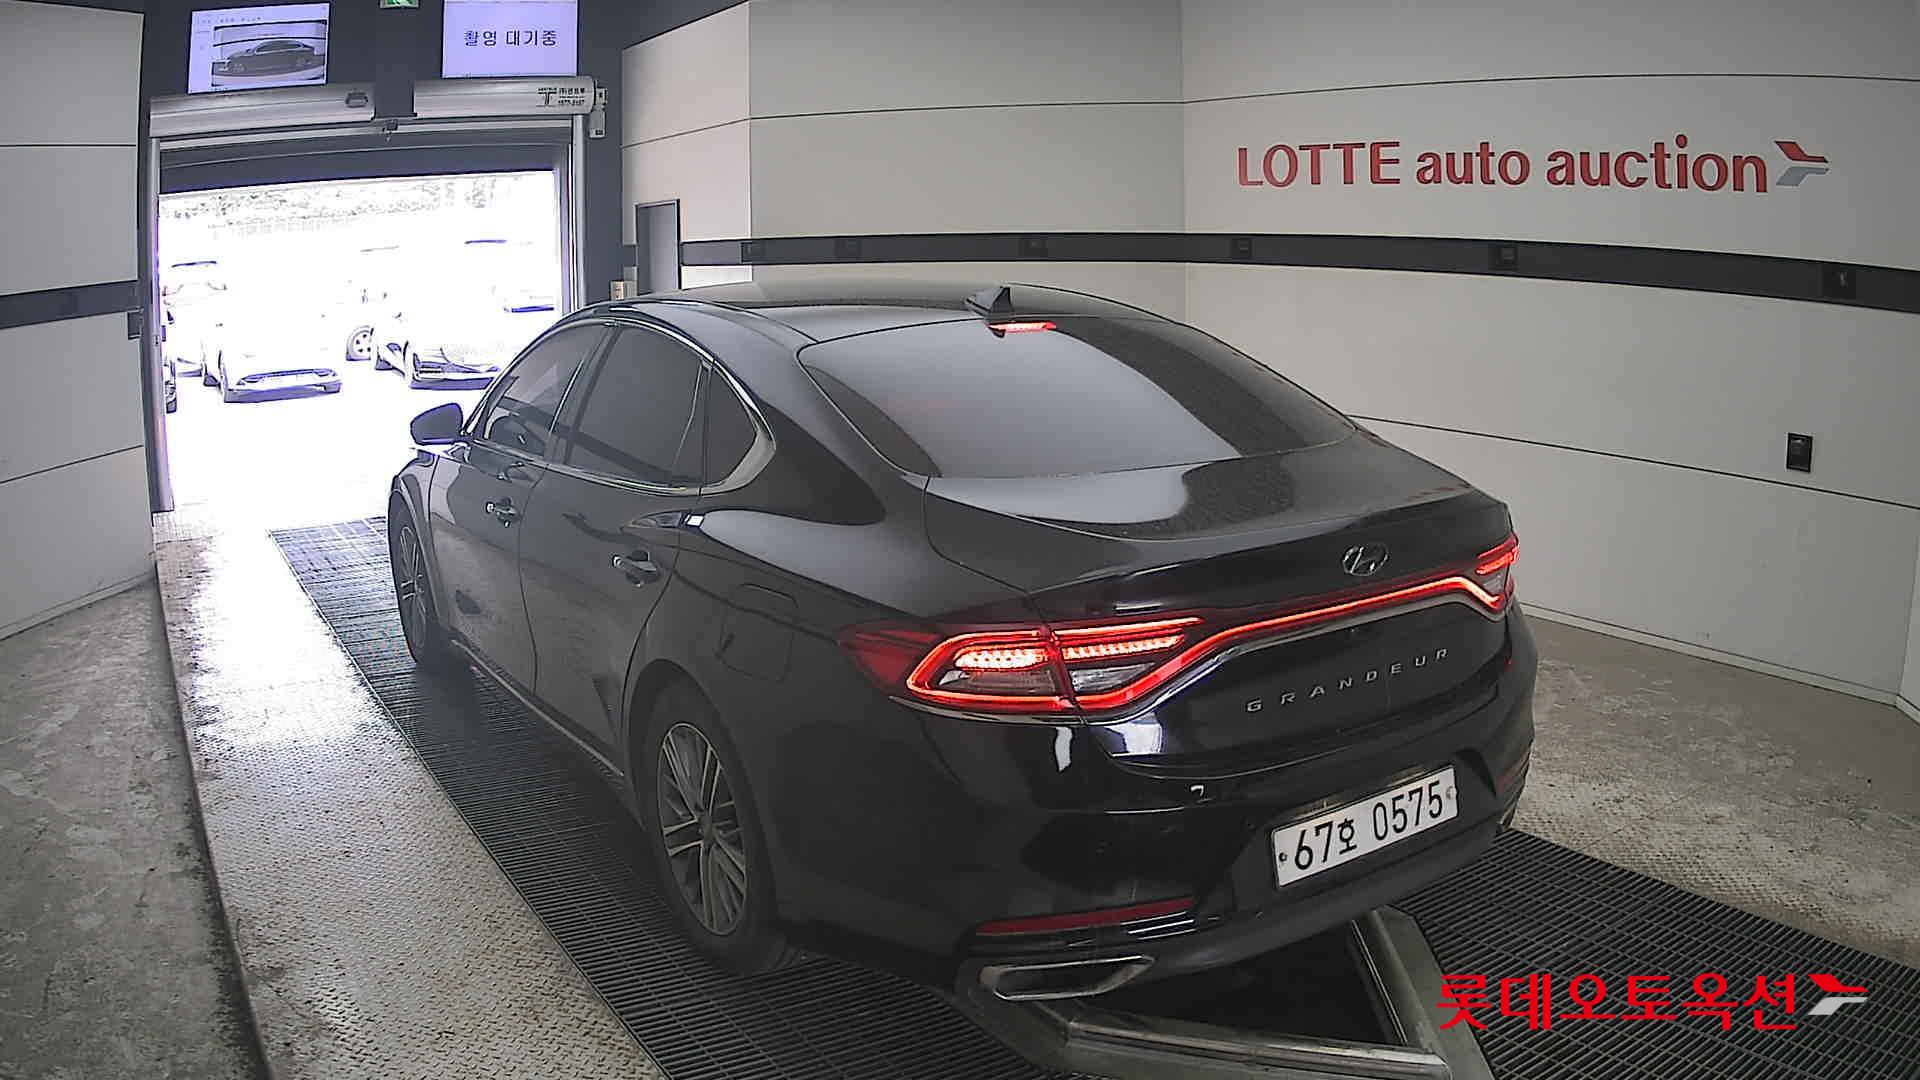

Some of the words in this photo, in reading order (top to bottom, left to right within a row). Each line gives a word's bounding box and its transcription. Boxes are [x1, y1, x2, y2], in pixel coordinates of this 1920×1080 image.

[464, 30, 497, 47] 촬영
[505, 30, 557, 46] 대기중
[1238, 141, 1400, 186] LOTTE
[1415, 141, 1530, 187] auto
[1546, 134, 1769, 193] auction
[1246, 648, 1449, 712] GRANDEUR
[1294, 817, 1358, 871] 67호
[1372, 779, 1444, 841] 0575
